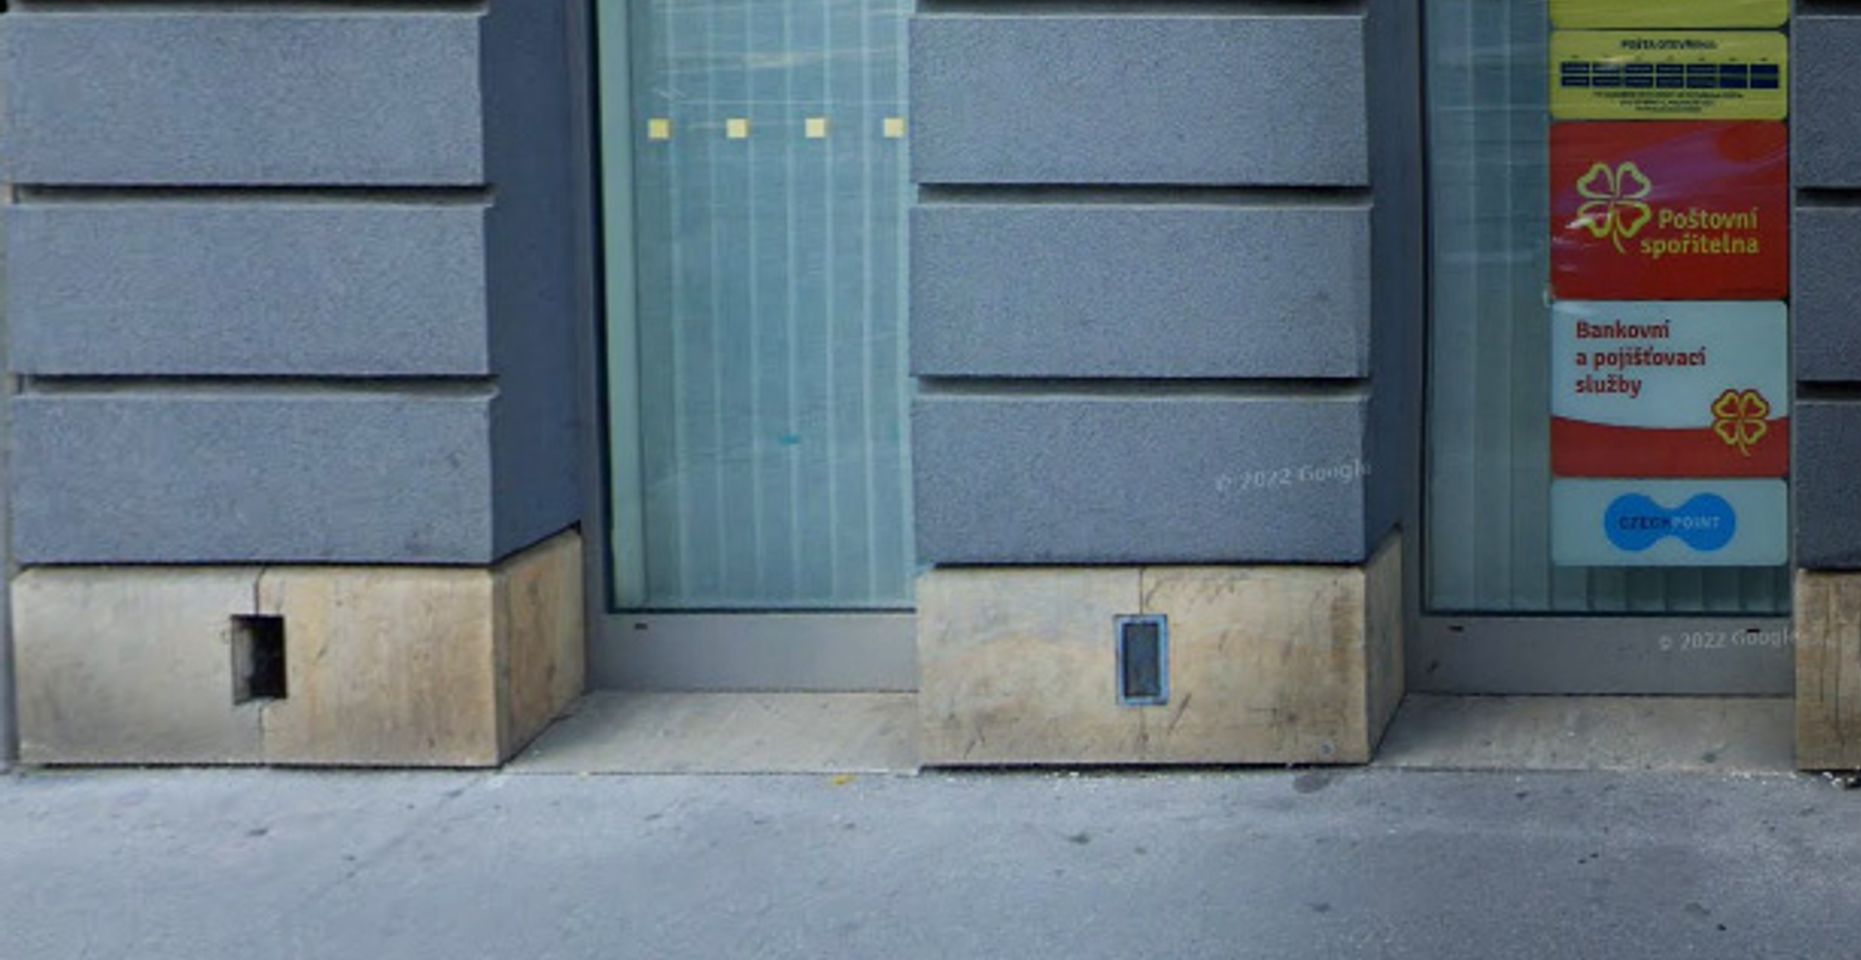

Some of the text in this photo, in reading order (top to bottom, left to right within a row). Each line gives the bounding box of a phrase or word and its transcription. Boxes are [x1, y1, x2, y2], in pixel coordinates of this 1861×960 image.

[1658, 207, 1758, 230] Poštovní
[1641, 235, 1760, 259] spořitelna
[1575, 319, 1671, 340] Bankovní
[1575, 345, 1707, 370] a pojišťovací
[1575, 373, 1642, 397] služby
